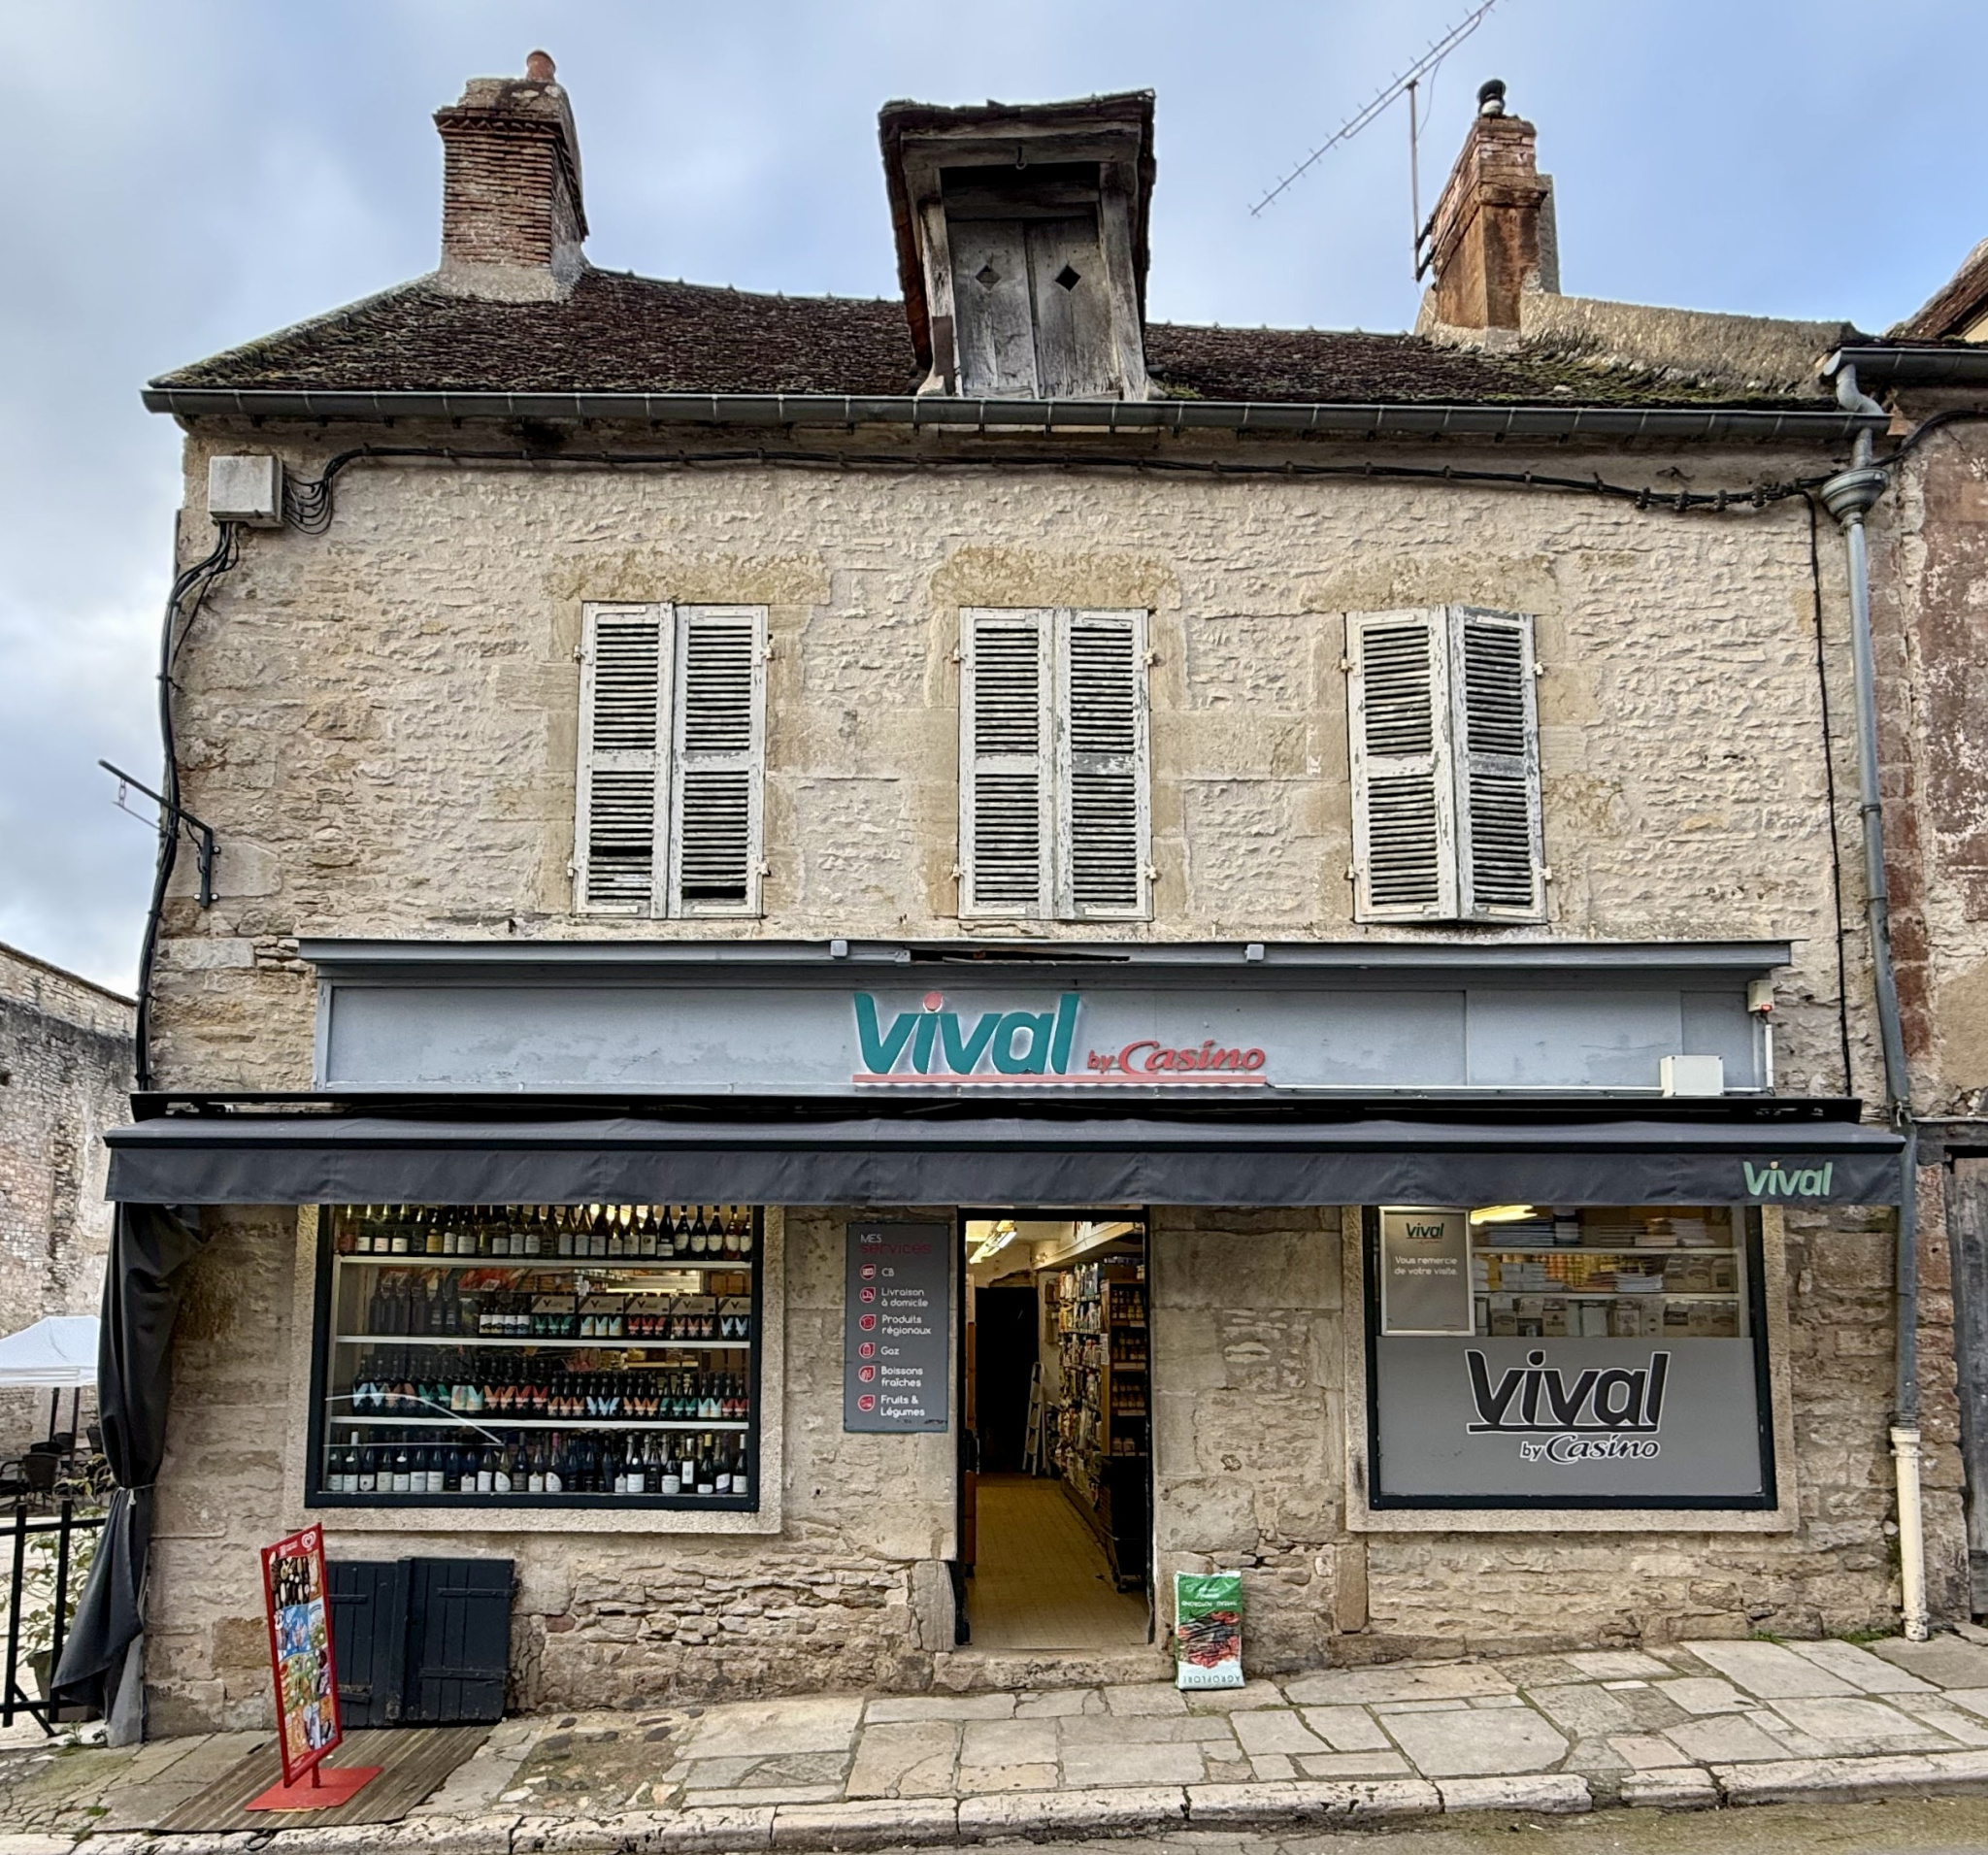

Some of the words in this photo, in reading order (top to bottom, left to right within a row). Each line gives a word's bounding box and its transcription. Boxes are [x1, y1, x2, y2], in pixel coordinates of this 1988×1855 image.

[854, 991, 1079, 1075] Vival
[1087, 1049, 1114, 1075] by
[1118, 1040, 1266, 1075] Casino
[1742, 1161, 1833, 1196] Vival
[1406, 1222, 1444, 1238] Vival
[860, 1234, 882, 1243] MES
[859, 1242, 932, 1254] services
[881, 1267, 895, 1277] CB
[881, 1286, 925, 1297] Livraison
[880, 1297, 888, 1307] à
[890, 1297, 929, 1308] domicile
[881, 1313, 922, 1324] Produits
[881, 1326, 932, 1337] régionaux
[880, 1345, 900, 1355] Gaz
[880, 1365, 924, 1375] Boissons
[881, 1376, 922, 1387] fraîches
[1465, 1348, 1671, 1426] Vival
[880, 1394, 910, 1405] Fruits
[911, 1394, 919, 1405] &
[880, 1406, 926, 1418] Légumes
[1520, 1441, 1545, 1462] by
[1544, 1433, 1661, 1465] Casino
